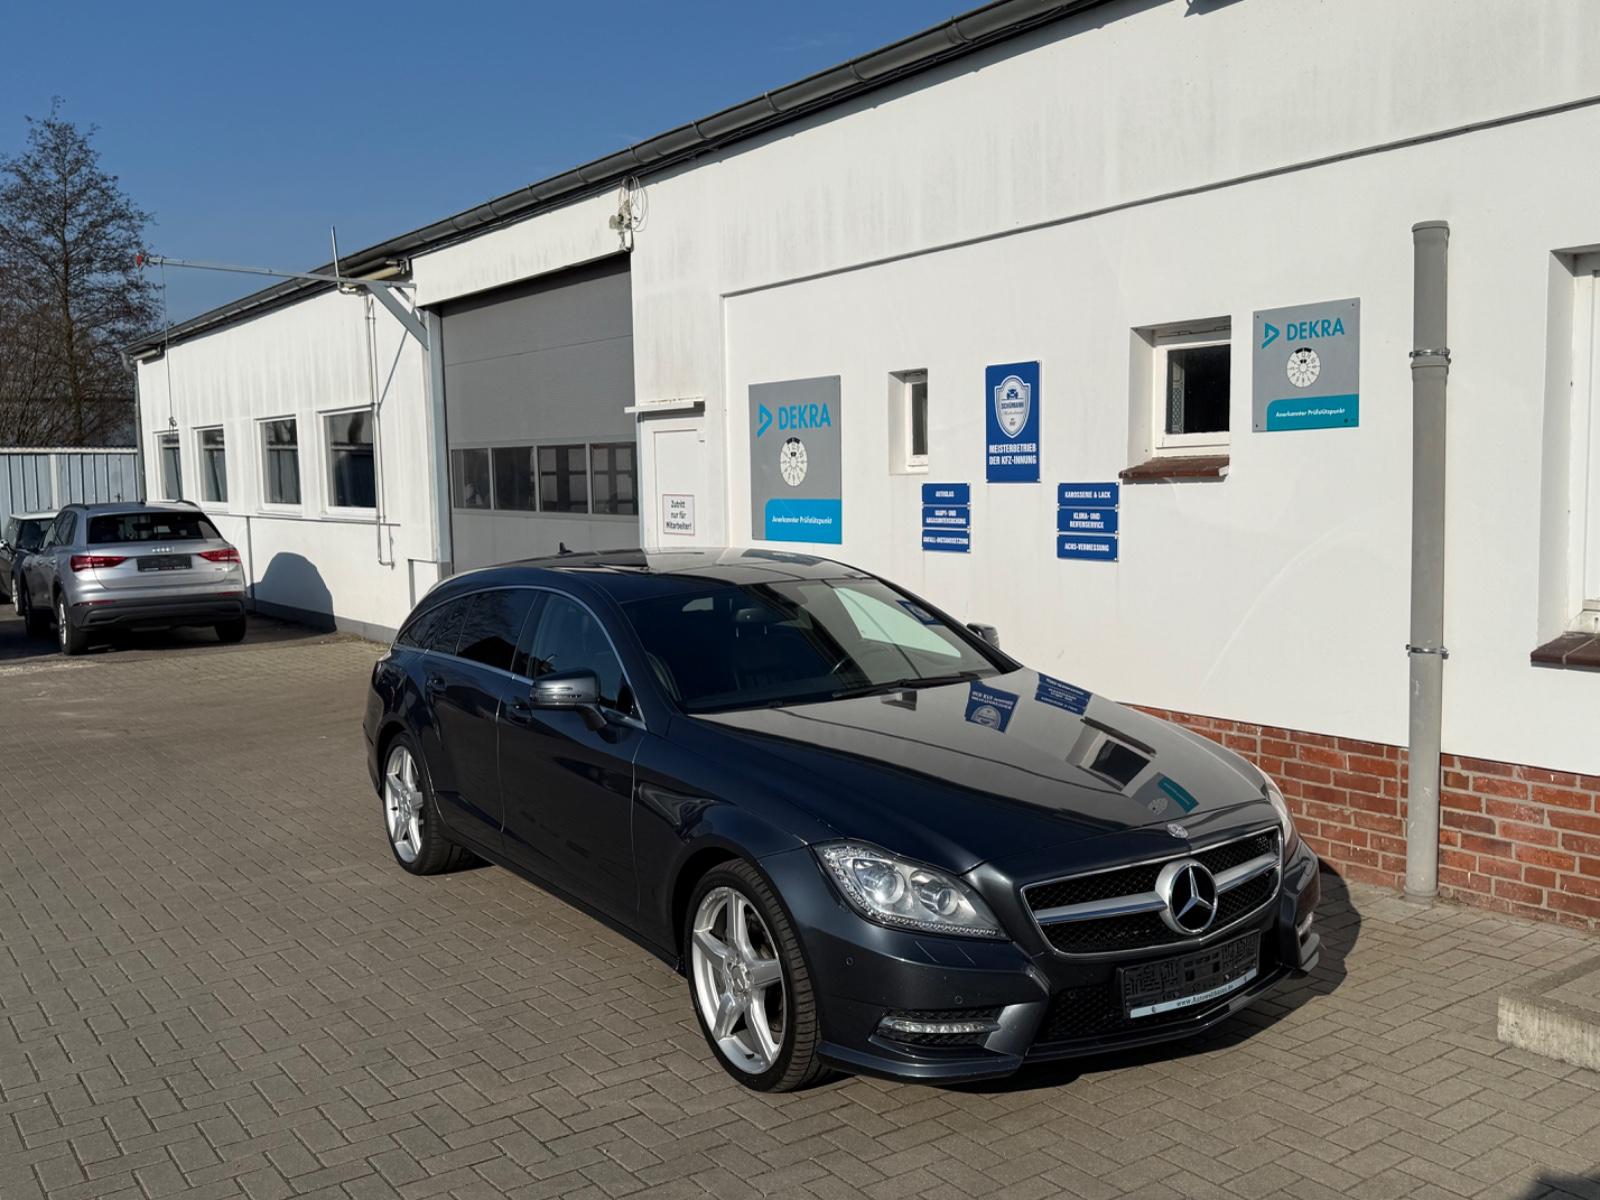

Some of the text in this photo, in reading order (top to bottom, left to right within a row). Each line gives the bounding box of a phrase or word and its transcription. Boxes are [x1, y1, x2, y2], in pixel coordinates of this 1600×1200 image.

[1286, 318, 1345, 342] DEKRA
[778, 402, 832, 431] DEKRA
[989, 443, 1037, 454] MEISTERBETRIEB
[989, 455, 1037, 464] DER KFZ-INNUNG
[1072, 512, 1089, 520] KLIMA-
[666, 521, 692, 530] Mitarbeiter!
[1070, 521, 1104, 529] REIFENSERVICE
[1064, 542, 1110, 552] ACHS-VERMESSUNG
